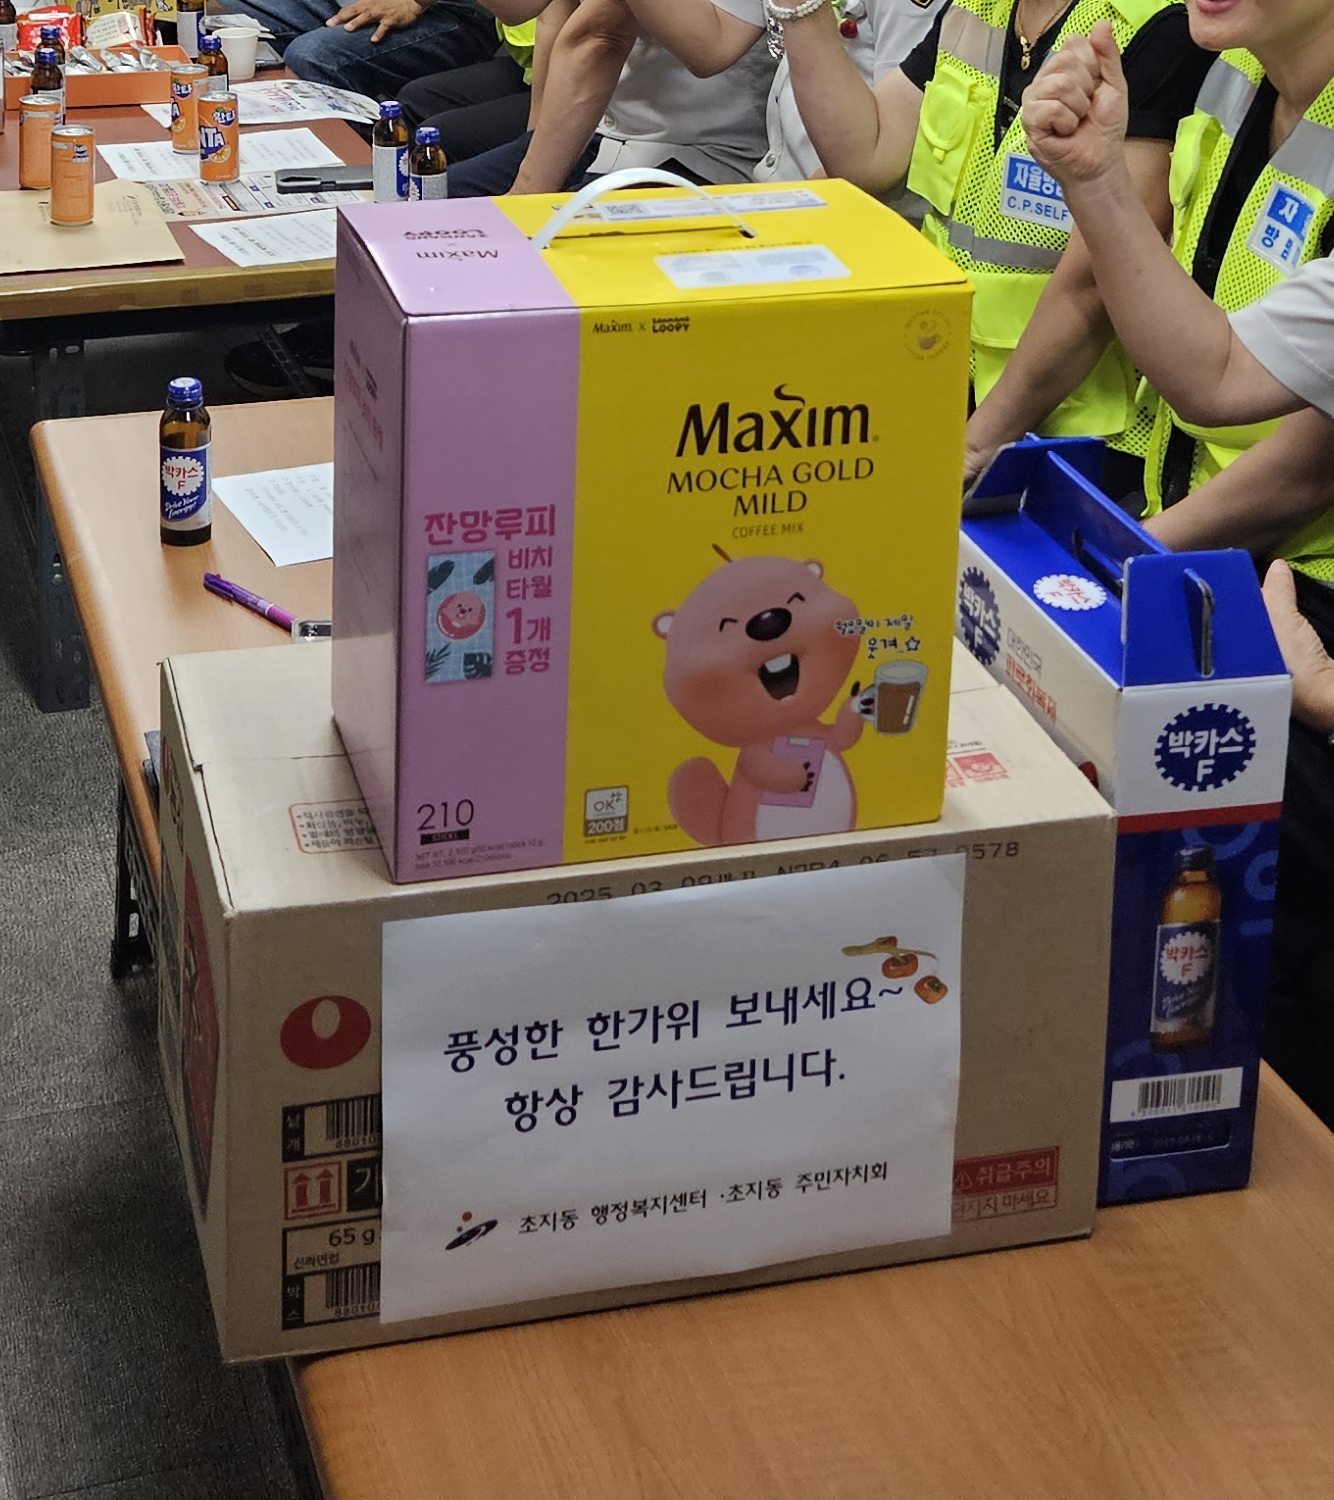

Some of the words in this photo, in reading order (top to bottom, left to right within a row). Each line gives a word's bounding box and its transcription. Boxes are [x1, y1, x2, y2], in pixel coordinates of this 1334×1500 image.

[417, 250, 498, 261] Maxim
[593, 320, 632, 333] Maxim
[652, 323, 690, 333] LOOPY
[675, 388, 870, 457] Maxim
[166, 465, 199, 478] 박카스
[667, 464, 783, 494] MOCHA
[793, 457, 874, 484] GOLD
[178, 480, 185, 490] F
[733, 490, 807, 517] MILD
[425, 504, 556, 546] 잔망루피
[732, 523, 777, 539] COFFEE
[781, 522, 804, 535] MIX
[508, 545, 553, 570] 비치
[506, 575, 552, 600] 타월
[1056, 578, 1092, 605] 박카스
[962, 585, 997, 638] 박카스
[506, 607, 551, 644] 1개
[974, 625, 985, 647] F
[504, 647, 550, 676] 증정
[1168, 727, 1245, 759] 박카스
[1196, 758, 1215, 783] F
[417, 799, 475, 831] 210
[594, 798, 615, 812] OK
[1165, 946, 1212, 964] 박카스
[1181, 964, 1192, 978] F
[443, 1018, 564, 1074] 풍성한
[586, 1000, 699, 1052] 한가위
[725, 977, 904, 1029] 보내세요~
[505, 1084, 584, 1133] 항상
[608, 1048, 846, 1118] 감사드립니다.
[975, 1156, 1051, 1187] 취급주의
[518, 1208, 579, 1235] 초지동
[591, 1189, 708, 1226] 행정복지센터
[794, 1161, 888, 1193] 주민자치회
[1002, 1188, 1050, 1211] 마세요
[328, 1228, 356, 1247] 65
